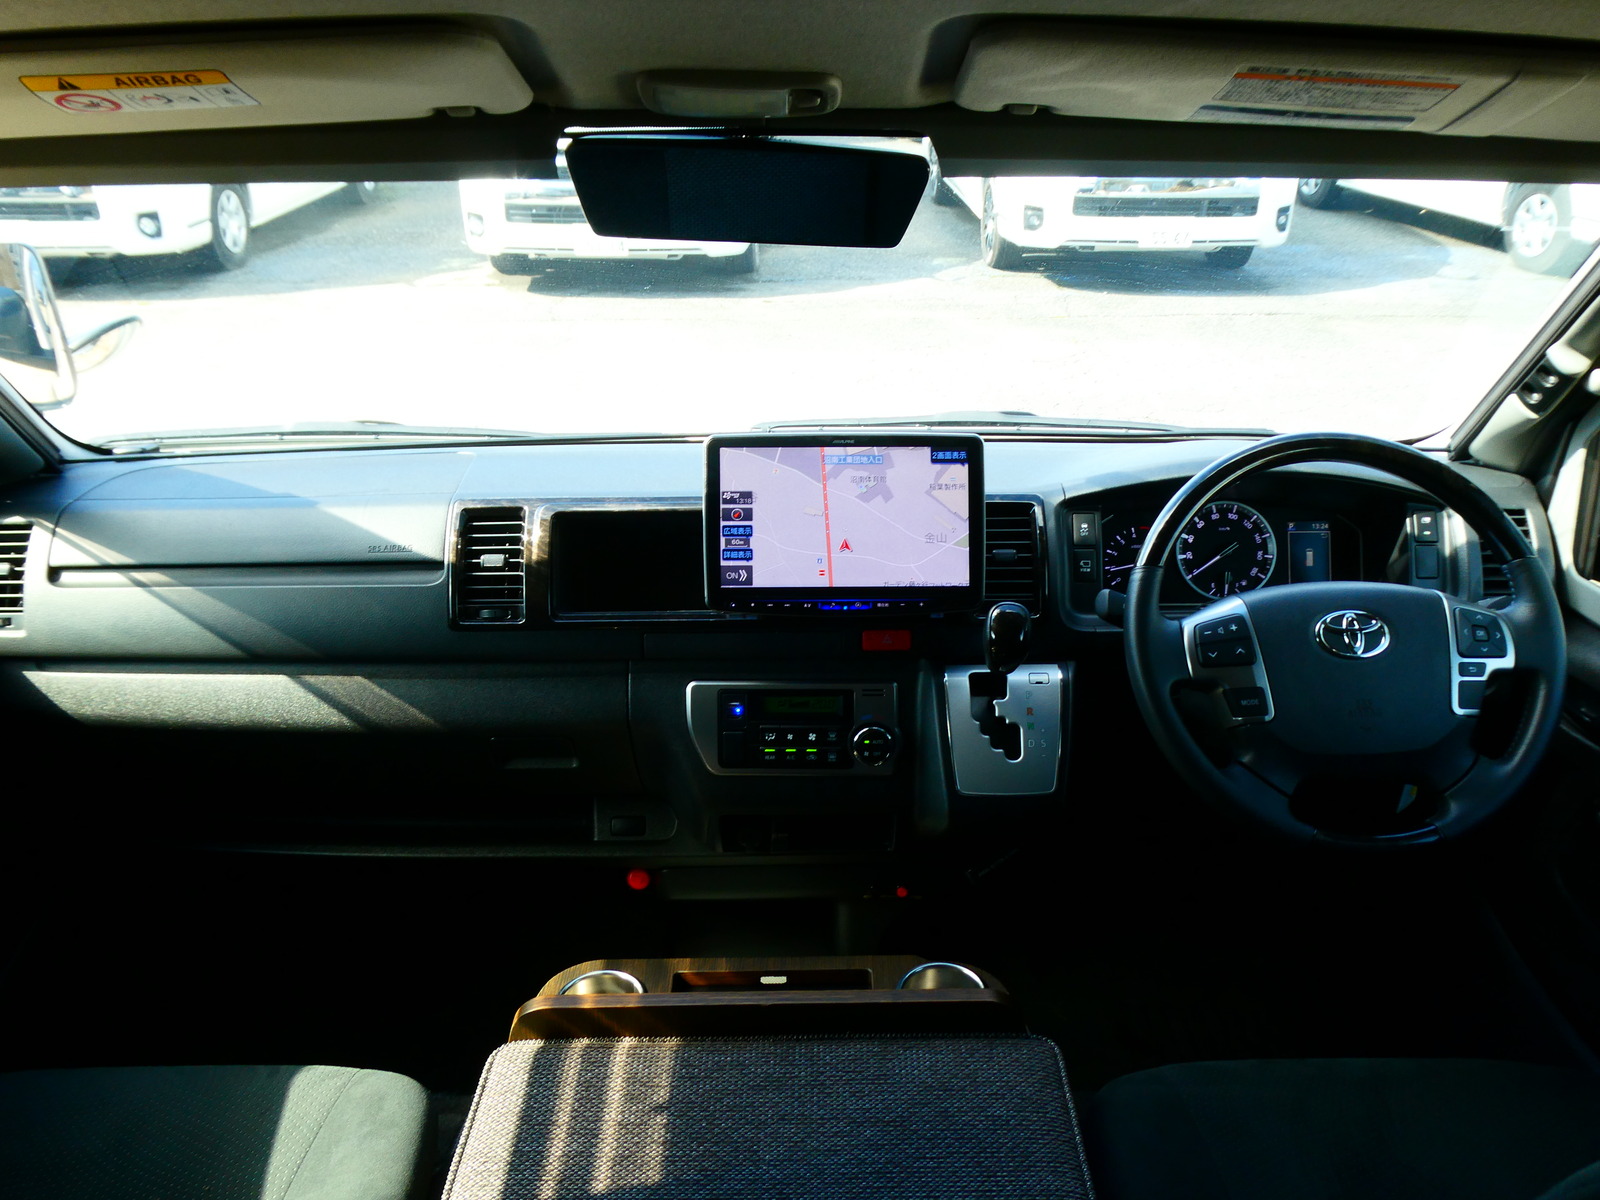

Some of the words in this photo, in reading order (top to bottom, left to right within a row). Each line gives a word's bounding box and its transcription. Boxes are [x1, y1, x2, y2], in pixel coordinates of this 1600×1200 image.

[114, 73, 203, 87] AIRBAG
[932, 451, 967, 460] 2画面表示
[1196, 520, 1205, 529] 60
[1242, 519, 1253, 530] 120
[723, 527, 752, 535] 広域表示
[924, 532, 947, 544] 金山
[1253, 532, 1262, 544] 140
[368, 545, 381, 553] SRS
[383, 544, 413, 552] AIRBAG
[723, 551, 752, 559] 詳細表示
[1256, 550, 1264, 561] 160
[1249, 567, 1259, 576] 180
[1026, 691, 1032, 699] P
[1240, 698, 1260, 706] MODE
[1026, 707, 1033, 716] R
[1040, 740, 1047, 748] S
